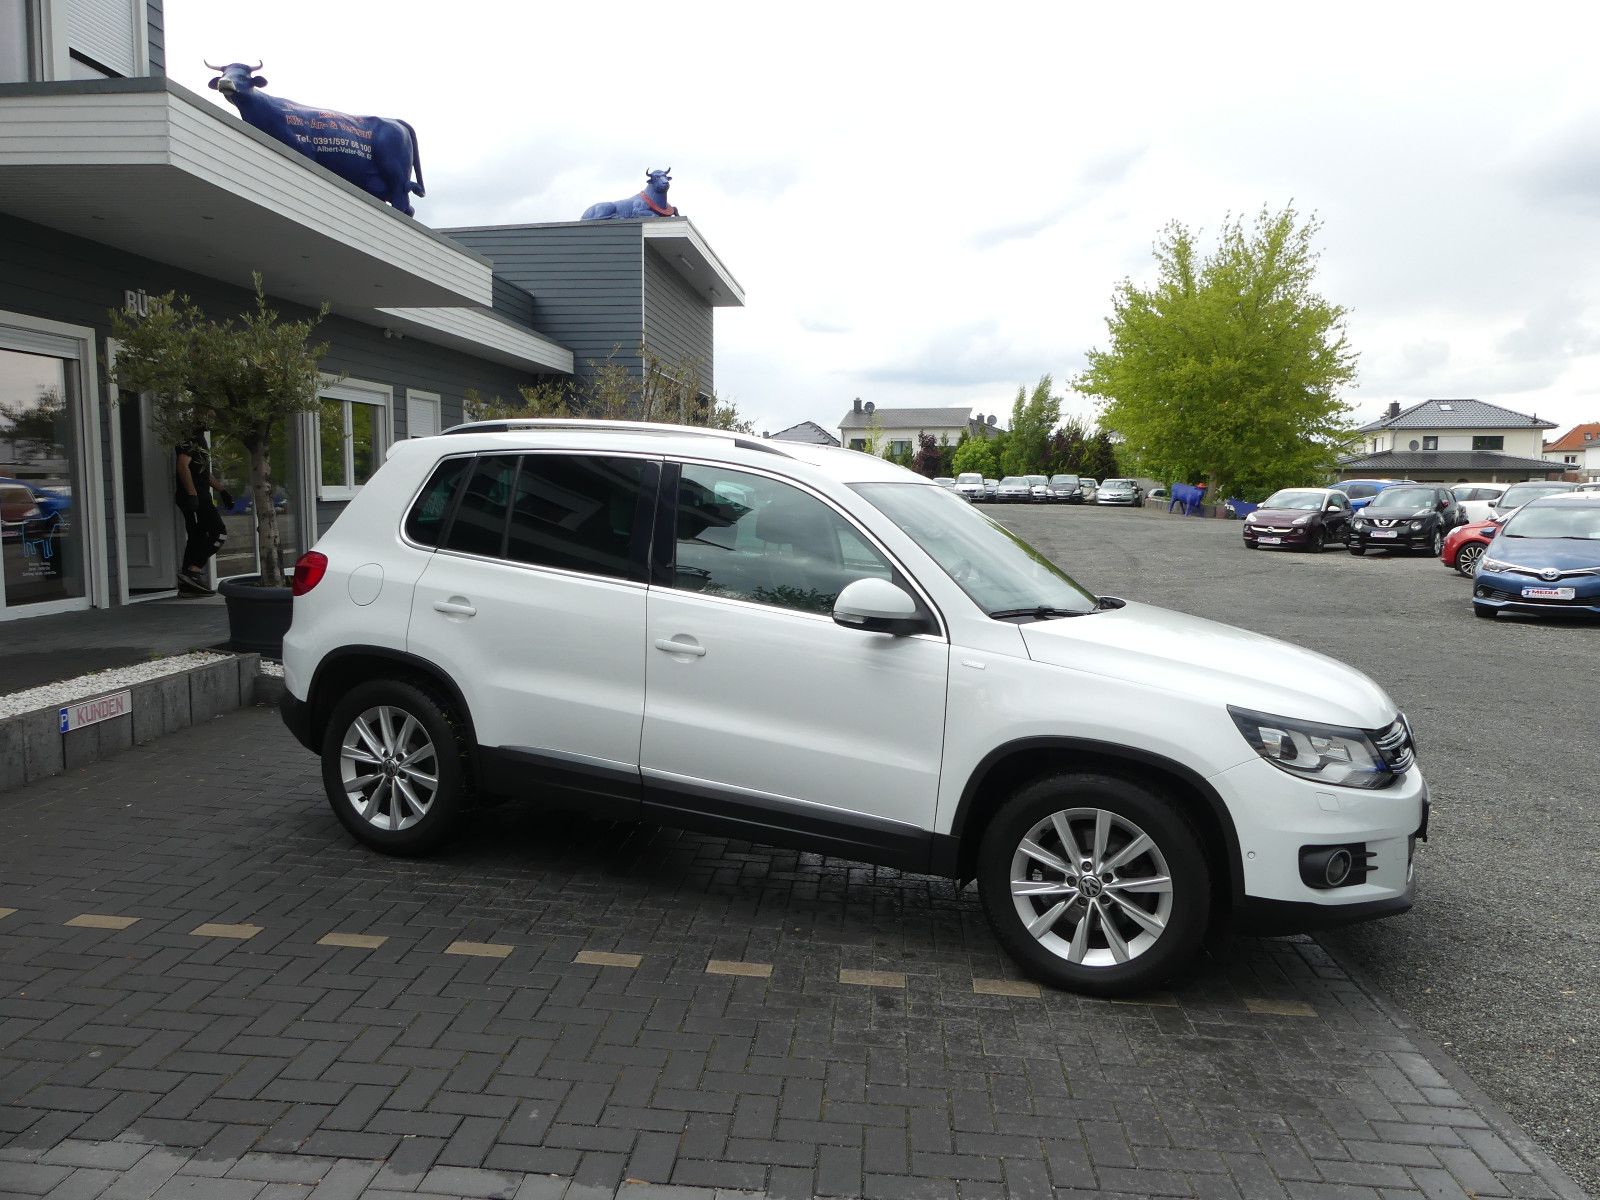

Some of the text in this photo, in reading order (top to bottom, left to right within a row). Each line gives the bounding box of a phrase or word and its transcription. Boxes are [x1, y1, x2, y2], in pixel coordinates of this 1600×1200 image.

[295, 134, 311, 143] Tel.
[313, 137, 349, 145] 0391/597
[77, 696, 123, 726] KUNDEN
